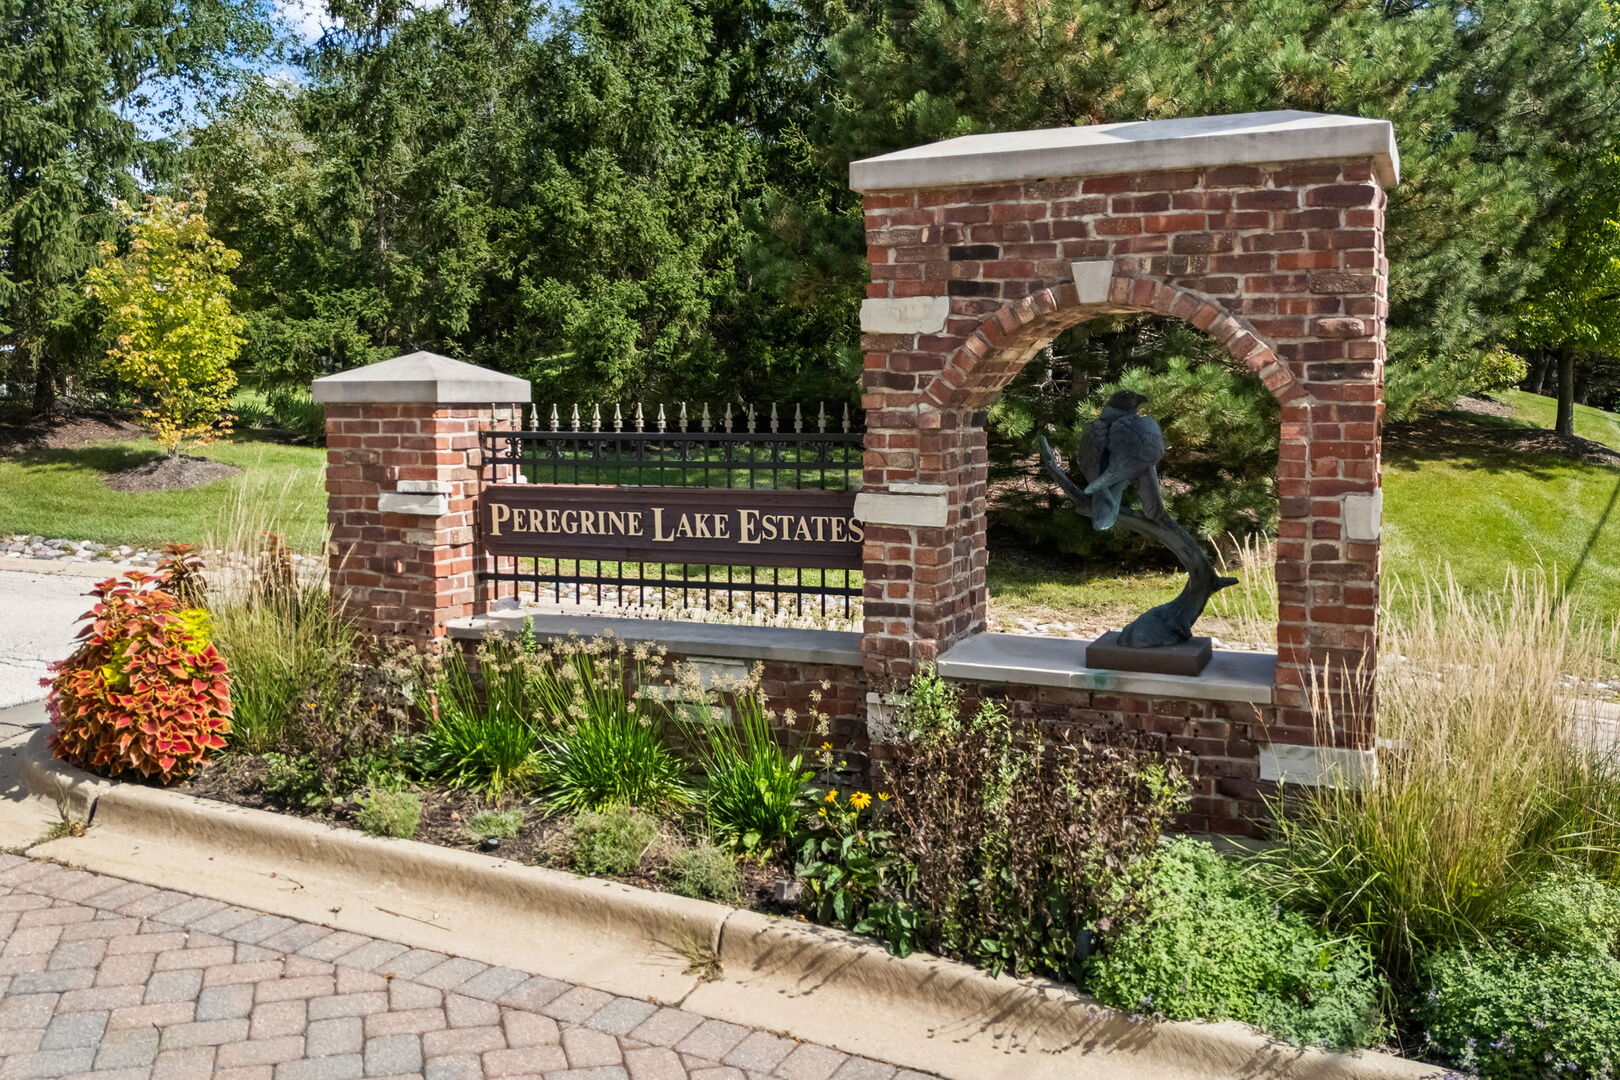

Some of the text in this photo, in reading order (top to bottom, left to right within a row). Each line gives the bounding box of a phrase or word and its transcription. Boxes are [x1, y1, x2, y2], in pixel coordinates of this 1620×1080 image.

[488, 502, 864, 544] PEREGRINE LAKE ESTATES
